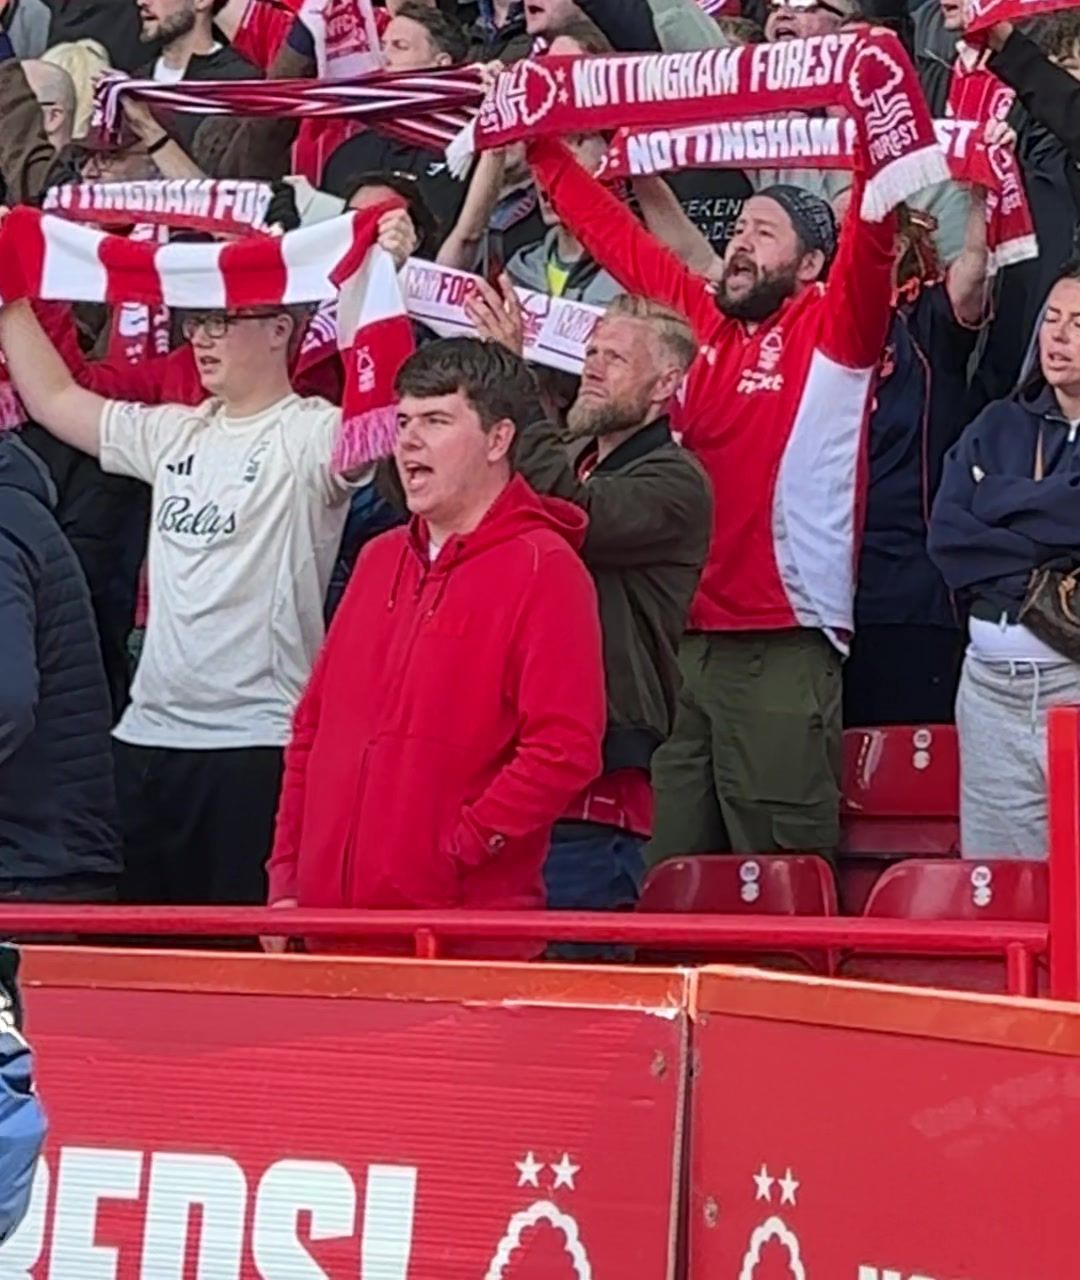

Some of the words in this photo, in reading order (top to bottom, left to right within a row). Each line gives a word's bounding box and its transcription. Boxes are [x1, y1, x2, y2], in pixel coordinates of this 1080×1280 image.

[572, 44, 746, 109] NOTTINGHAM
[750, 32, 858, 93] FOREST
[626, 117, 841, 175] NOTTINGHAM
[0, 1146, 418, 1280] EDS!
